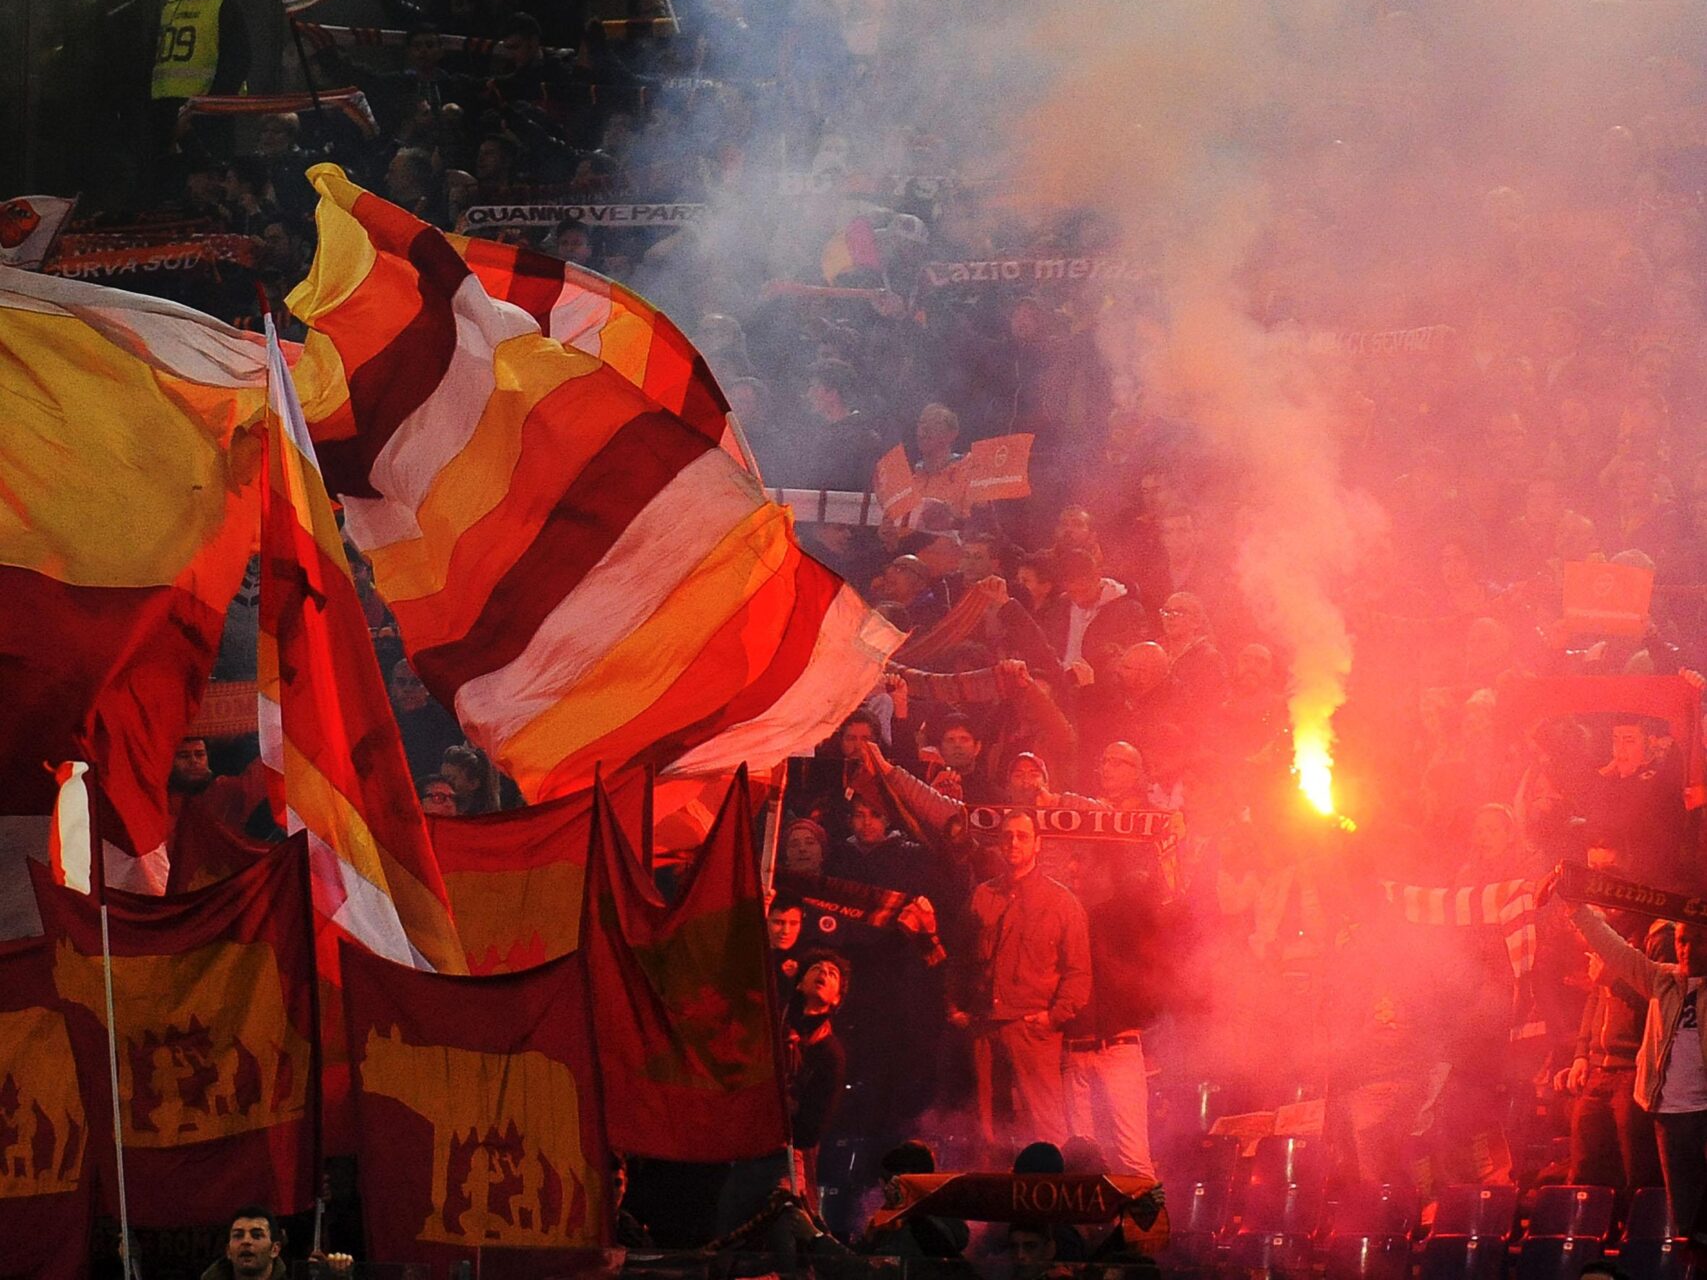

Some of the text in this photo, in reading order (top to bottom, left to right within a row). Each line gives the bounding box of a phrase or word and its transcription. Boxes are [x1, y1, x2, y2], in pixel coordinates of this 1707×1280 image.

[467, 205, 583, 225] QUANNO
[142, 251, 203, 272] SUD
[924, 259, 1021, 286] Lazio
[969, 807, 1082, 832] OIO
[1011, 1179, 1107, 1213] ROMA
